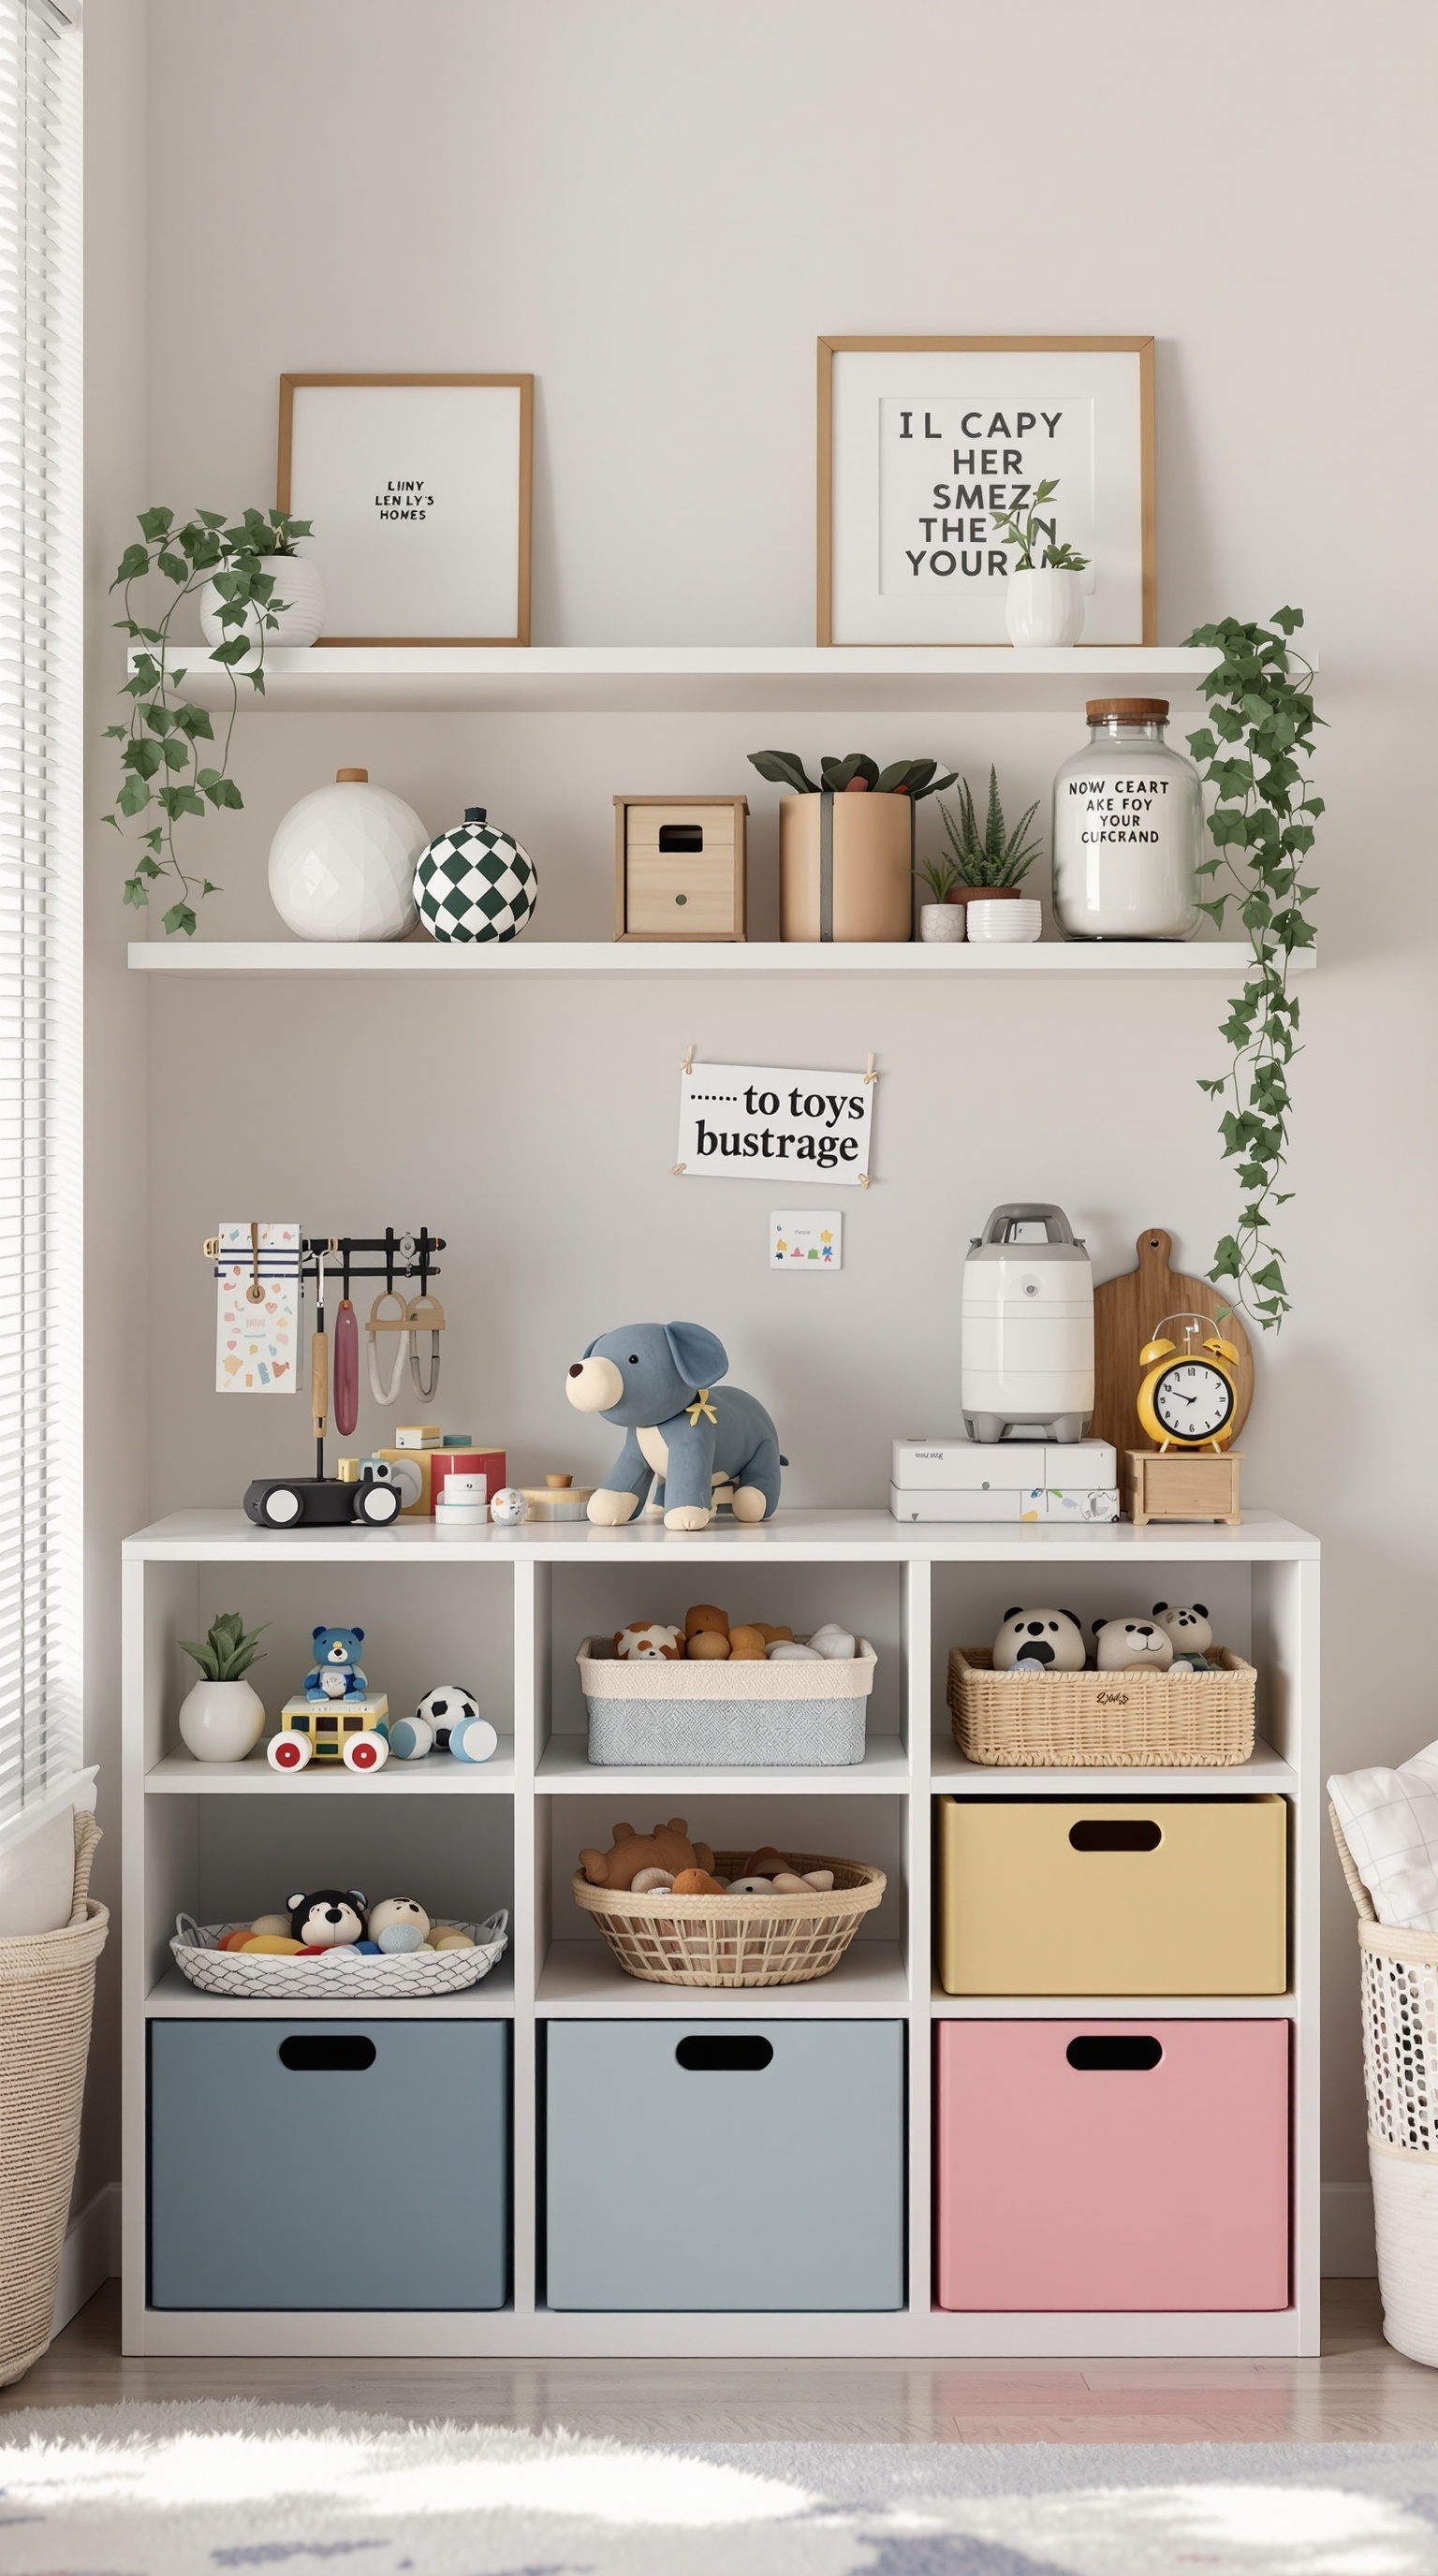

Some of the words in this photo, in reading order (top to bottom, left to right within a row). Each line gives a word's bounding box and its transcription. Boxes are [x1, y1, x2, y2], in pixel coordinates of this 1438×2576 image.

[961, 412, 1063, 438] CAPY
[953, 449, 1023, 475] HER
[918, 518, 987, 543] THE
[905, 550, 1008, 577] YOUR
[1069, 781, 1106, 795] NOW
[1114, 781, 1169, 794] CEART
[1086, 798, 1114, 812] AKE
[1123, 798, 1152, 811] FOY
[1100, 814, 1140, 827] YOUR
[743, 1085, 781, 1116] to
[788, 1087, 865, 1128] toys
[696, 1120, 858, 1168] bustrage
